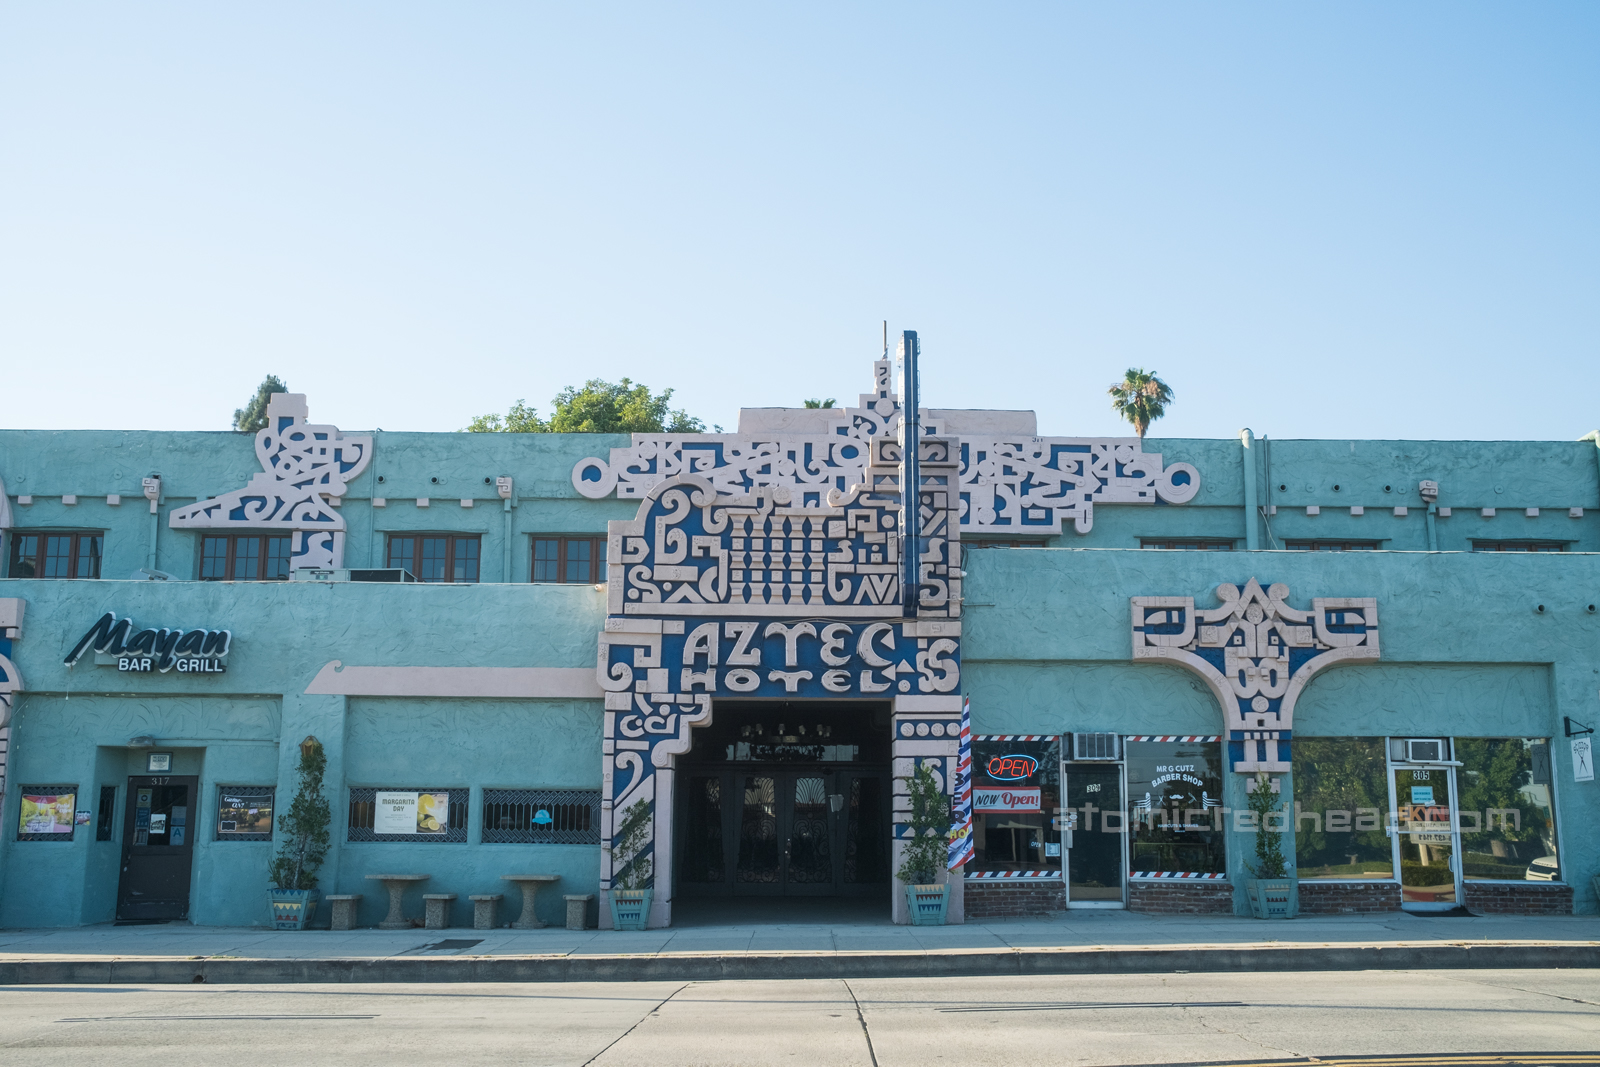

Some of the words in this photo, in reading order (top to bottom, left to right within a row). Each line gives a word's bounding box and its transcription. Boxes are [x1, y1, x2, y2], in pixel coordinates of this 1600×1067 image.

[64, 611, 232, 673] Mayan
[682, 622, 893, 667] AZTEC
[118, 658, 151, 671] BAR
[176, 658, 223, 672] GRILL
[681, 669, 891, 693] HOTEL
[988, 757, 1035, 777] OPEN
[1175, 764, 1194, 772] CUTZ
[151, 777, 170, 786] 317
[1152, 773, 1181, 787] BARBER
[1182, 774, 1203, 787] SHOP
[1414, 771, 1429, 780] 305
[975, 795, 1000, 806] NOW
[1001, 792, 1039, 808] Open!
